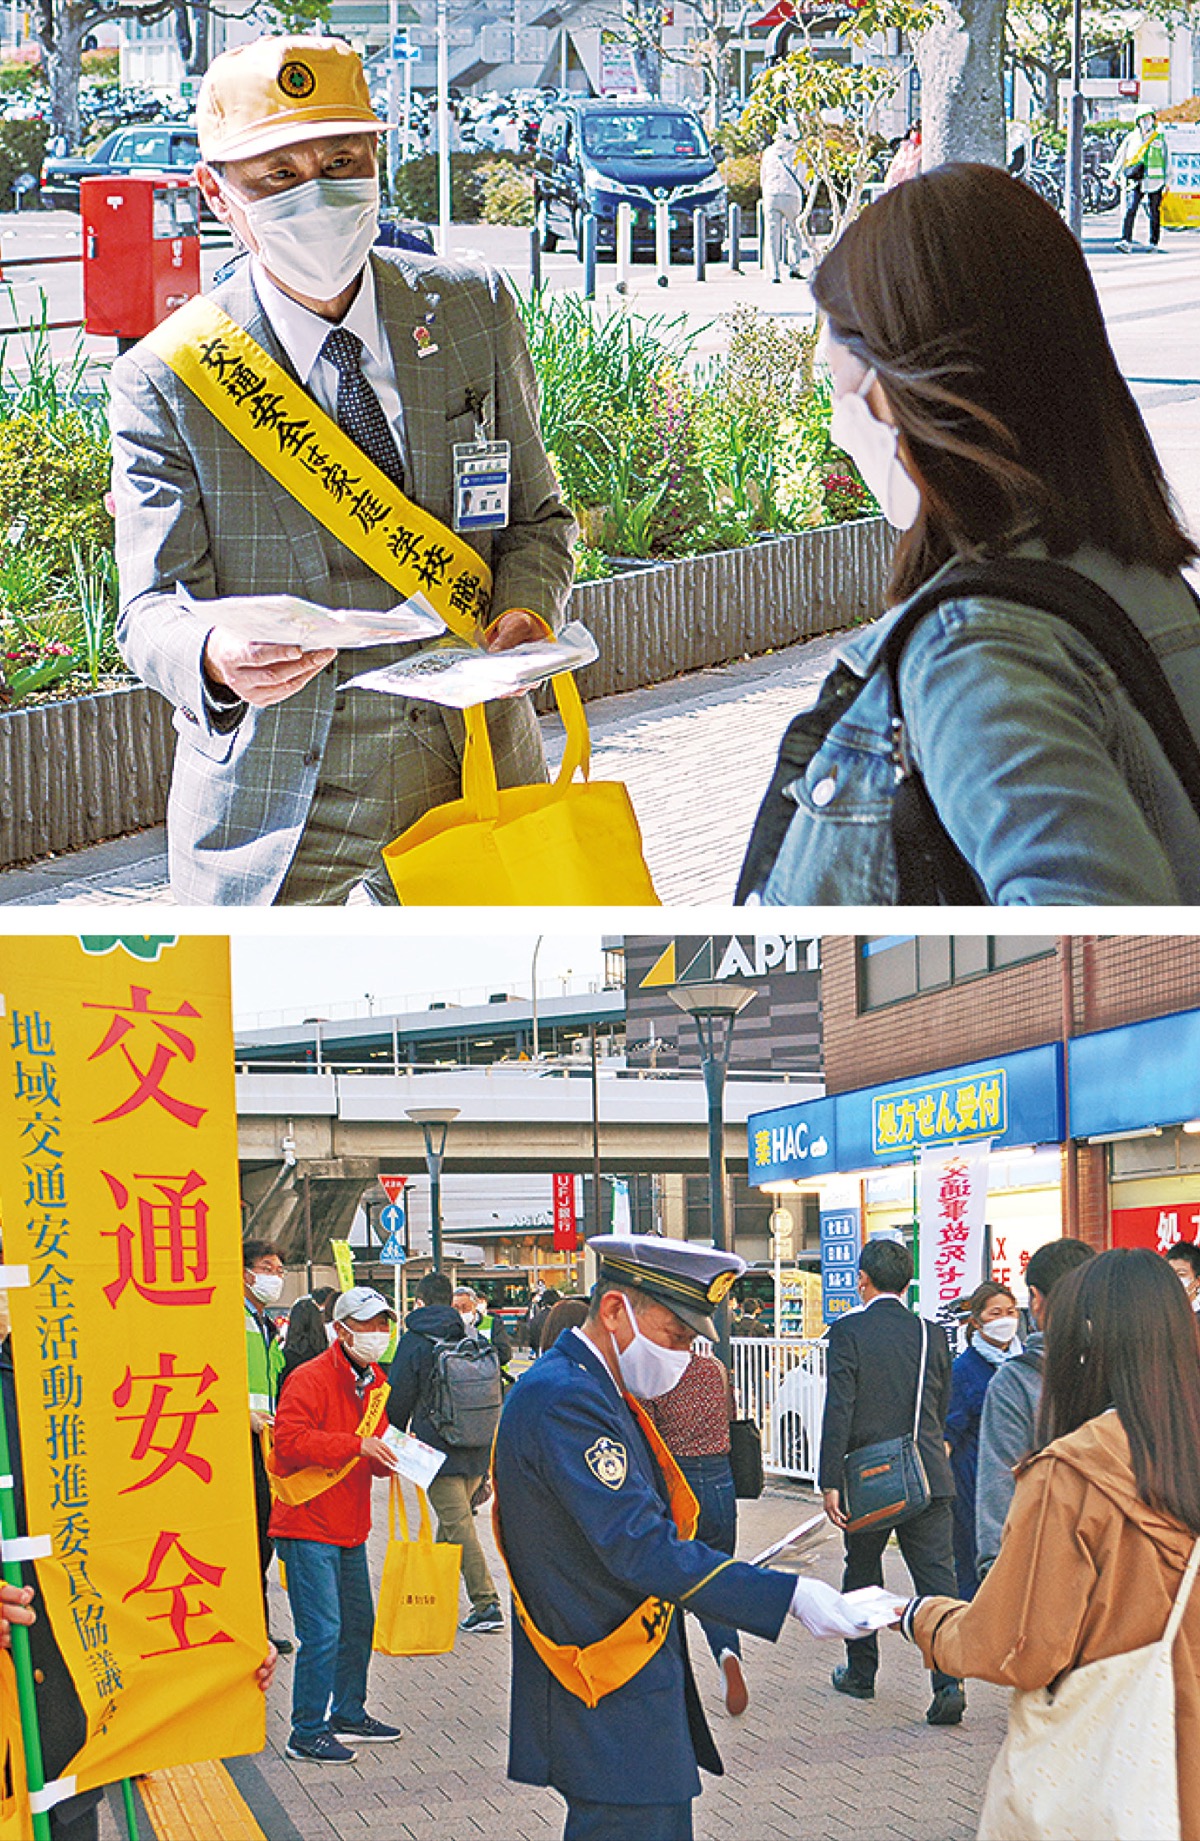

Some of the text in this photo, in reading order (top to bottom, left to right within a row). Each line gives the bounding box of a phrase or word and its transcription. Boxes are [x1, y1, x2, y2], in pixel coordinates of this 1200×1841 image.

[877, 1079, 1002, 1145] 処方せん受付
[82, 984, 235, 1660] 交通安全
